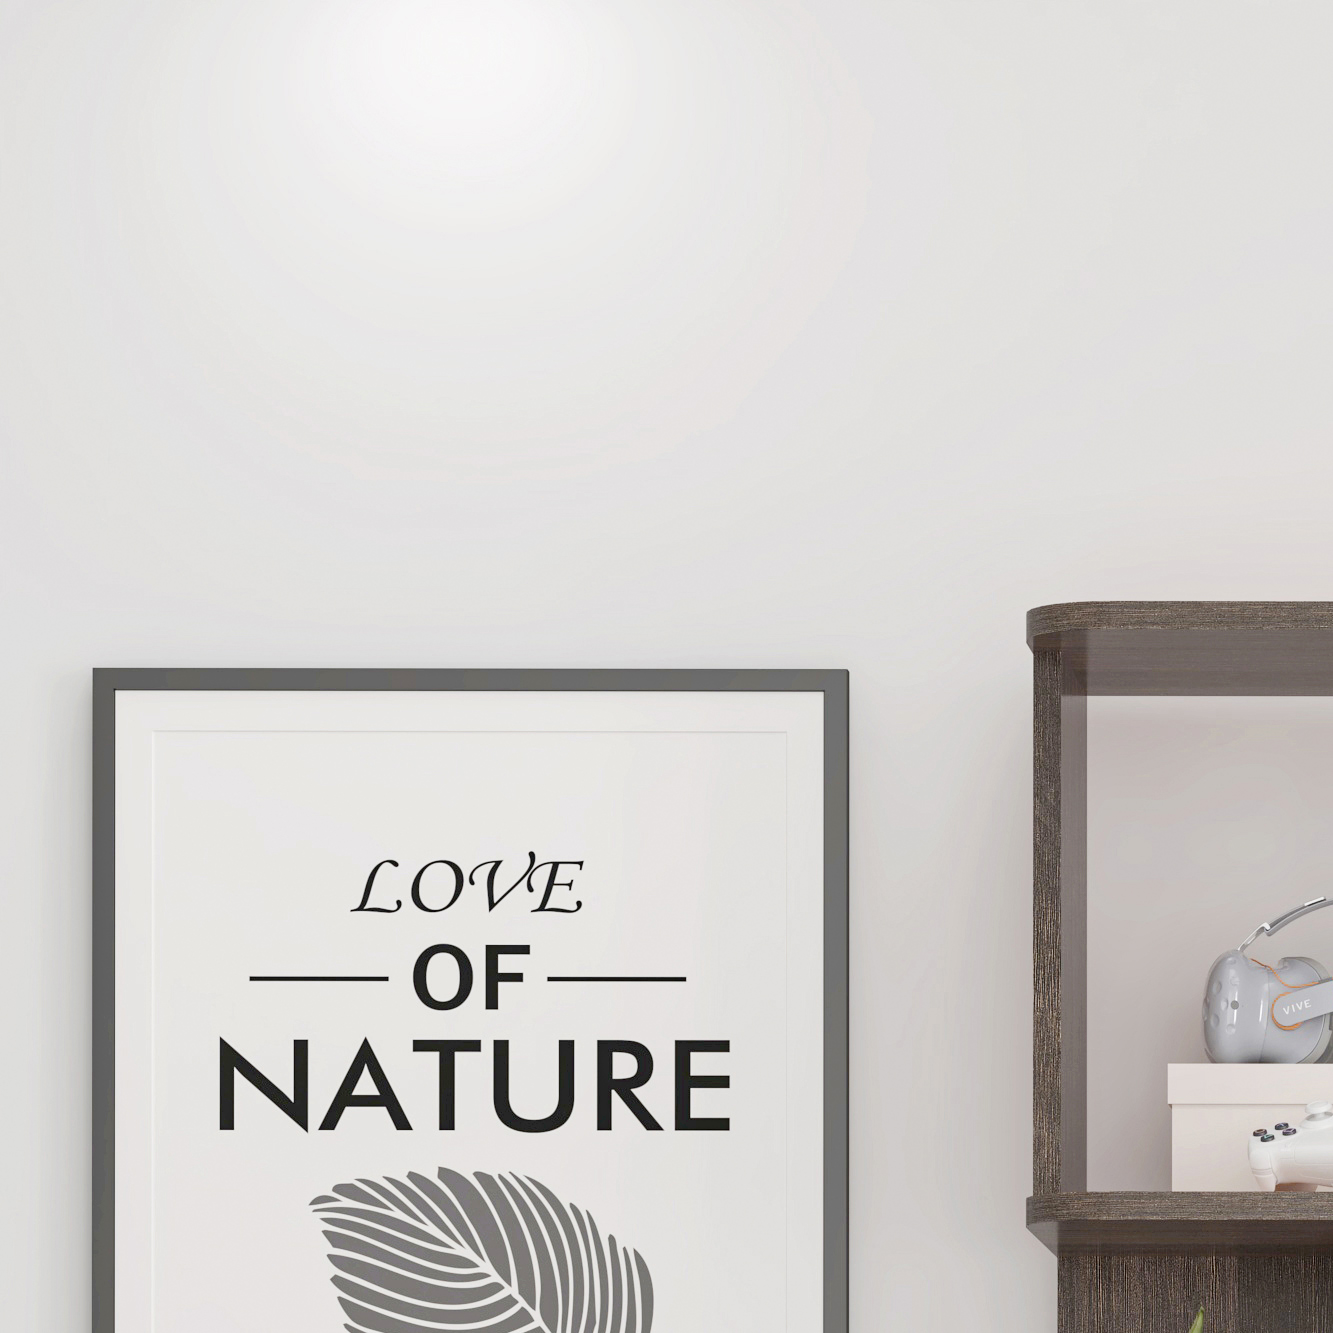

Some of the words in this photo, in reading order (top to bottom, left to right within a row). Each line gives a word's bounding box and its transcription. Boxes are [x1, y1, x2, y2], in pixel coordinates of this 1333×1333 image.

[349, 850, 584, 913] LOVE
[411, 942, 530, 1010] OF
[1282, 998, 1311, 1015] VIVE
[218, 1035, 730, 1132] NATURE
